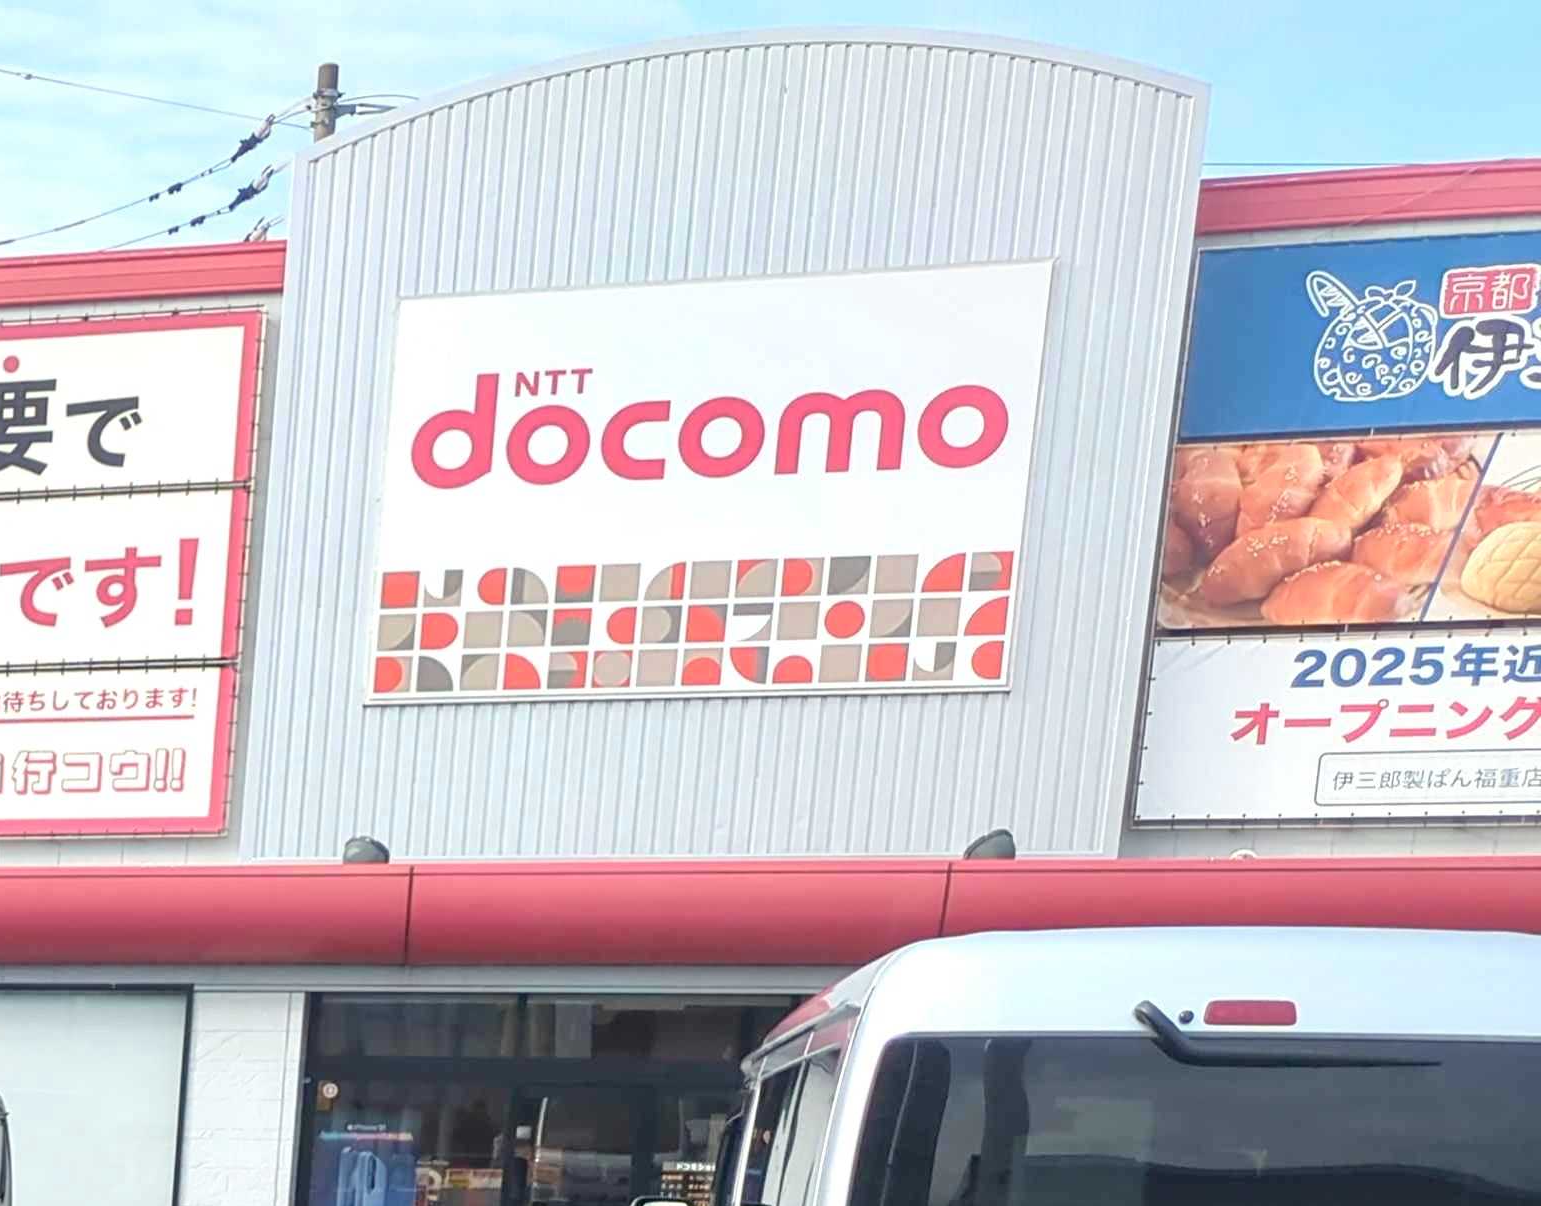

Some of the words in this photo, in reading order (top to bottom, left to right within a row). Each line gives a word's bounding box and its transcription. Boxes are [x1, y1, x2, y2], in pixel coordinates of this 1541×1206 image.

[1450, 272, 1530, 313] 京都
[1434, 318, 1541, 394] 伊
[514, 367, 593, 397] NTT
[411, 372, 1009, 490] docomo
[1290, 643, 1541, 688] 2025年近
